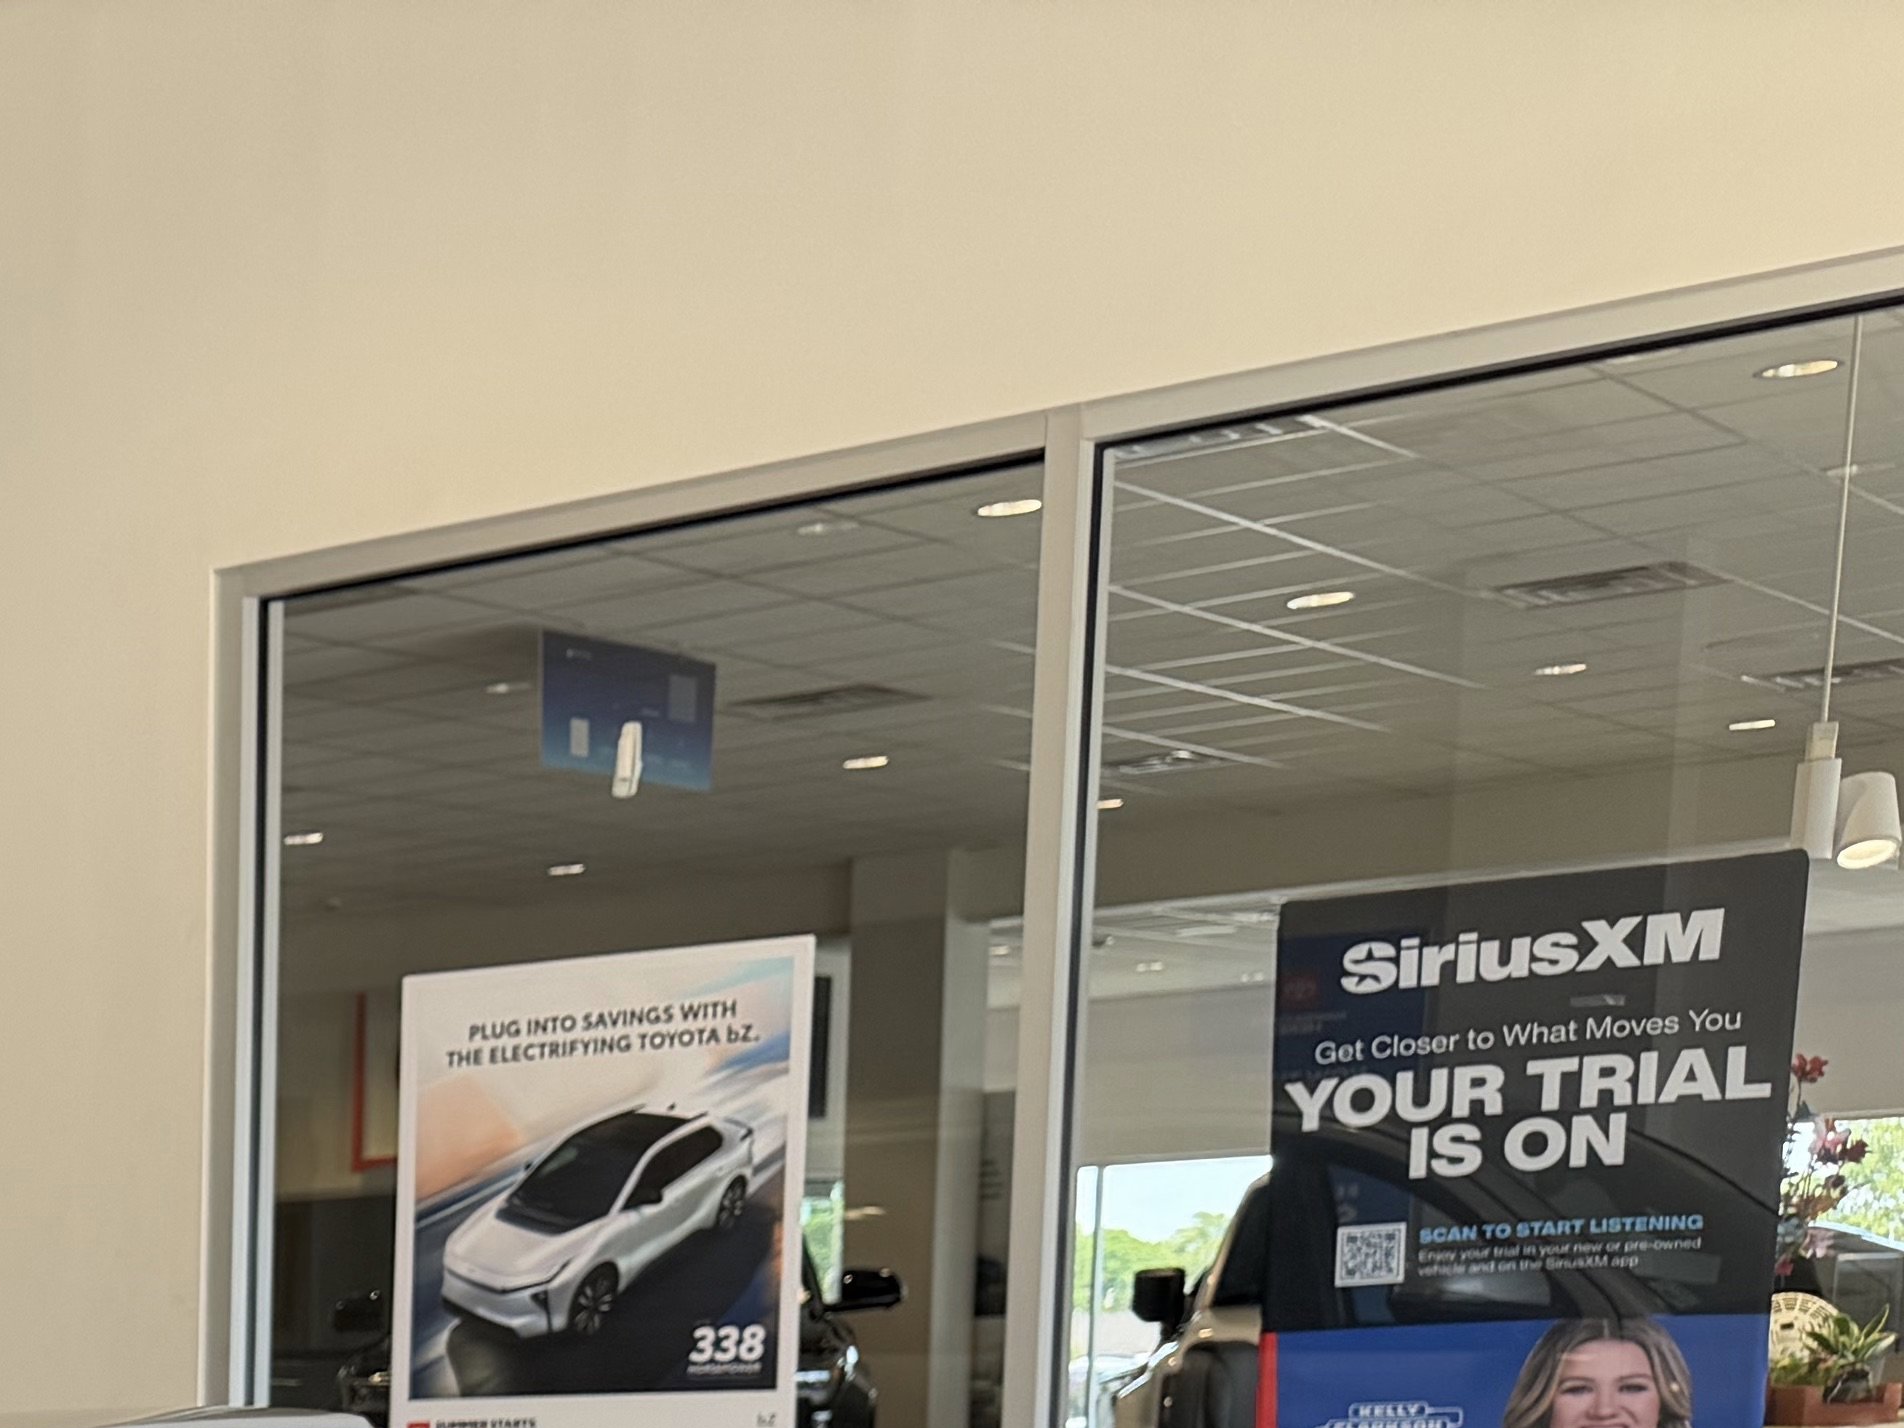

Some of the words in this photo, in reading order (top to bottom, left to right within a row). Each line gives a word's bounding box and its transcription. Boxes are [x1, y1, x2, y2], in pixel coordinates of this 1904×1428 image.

[1340, 908, 1725, 994] SiriusXM
[468, 1020, 521, 1042] PLUG
[526, 1014, 577, 1036] INTO
[581, 1003, 674, 1032] SAVINGS
[679, 999, 737, 1021] WITH
[1314, 1039, 1364, 1066] Get
[1371, 1032, 1460, 1058] Closer
[1468, 1028, 1494, 1051] to
[1502, 1021, 1578, 1047] What
[1586, 1014, 1680, 1042] Moves
[1688, 1008, 1742, 1032] You
[446, 1048, 483, 1068] THE
[488, 1034, 632, 1065] ELECTRIFYING
[638, 1028, 721, 1051] TOYOTA
[1284, 1063, 1505, 1133] YOUR
[1526, 1045, 1772, 1113] TRIAL
[1408, 1124, 1482, 1180] IS
[1503, 1112, 1628, 1172] ON
[1419, 1225, 1478, 1244] SCAN
[1482, 1222, 1511, 1240] TO
[1516, 1218, 1585, 1239] START
[1590, 1214, 1704, 1235] LISTENING
[1460, 1246, 1492, 1261] your
[1493, 1244, 1521, 1258] trial
[1522, 1244, 1537, 1256] in
[1539, 1243, 1570, 1258] your
[1573, 1242, 1604, 1254] new
[1606, 1241, 1622, 1253] or
[1624, 1236, 1702, 1254] pre-owned
[688, 1323, 767, 1364] 338
[1359, 1403, 1421, 1418] KELLY
